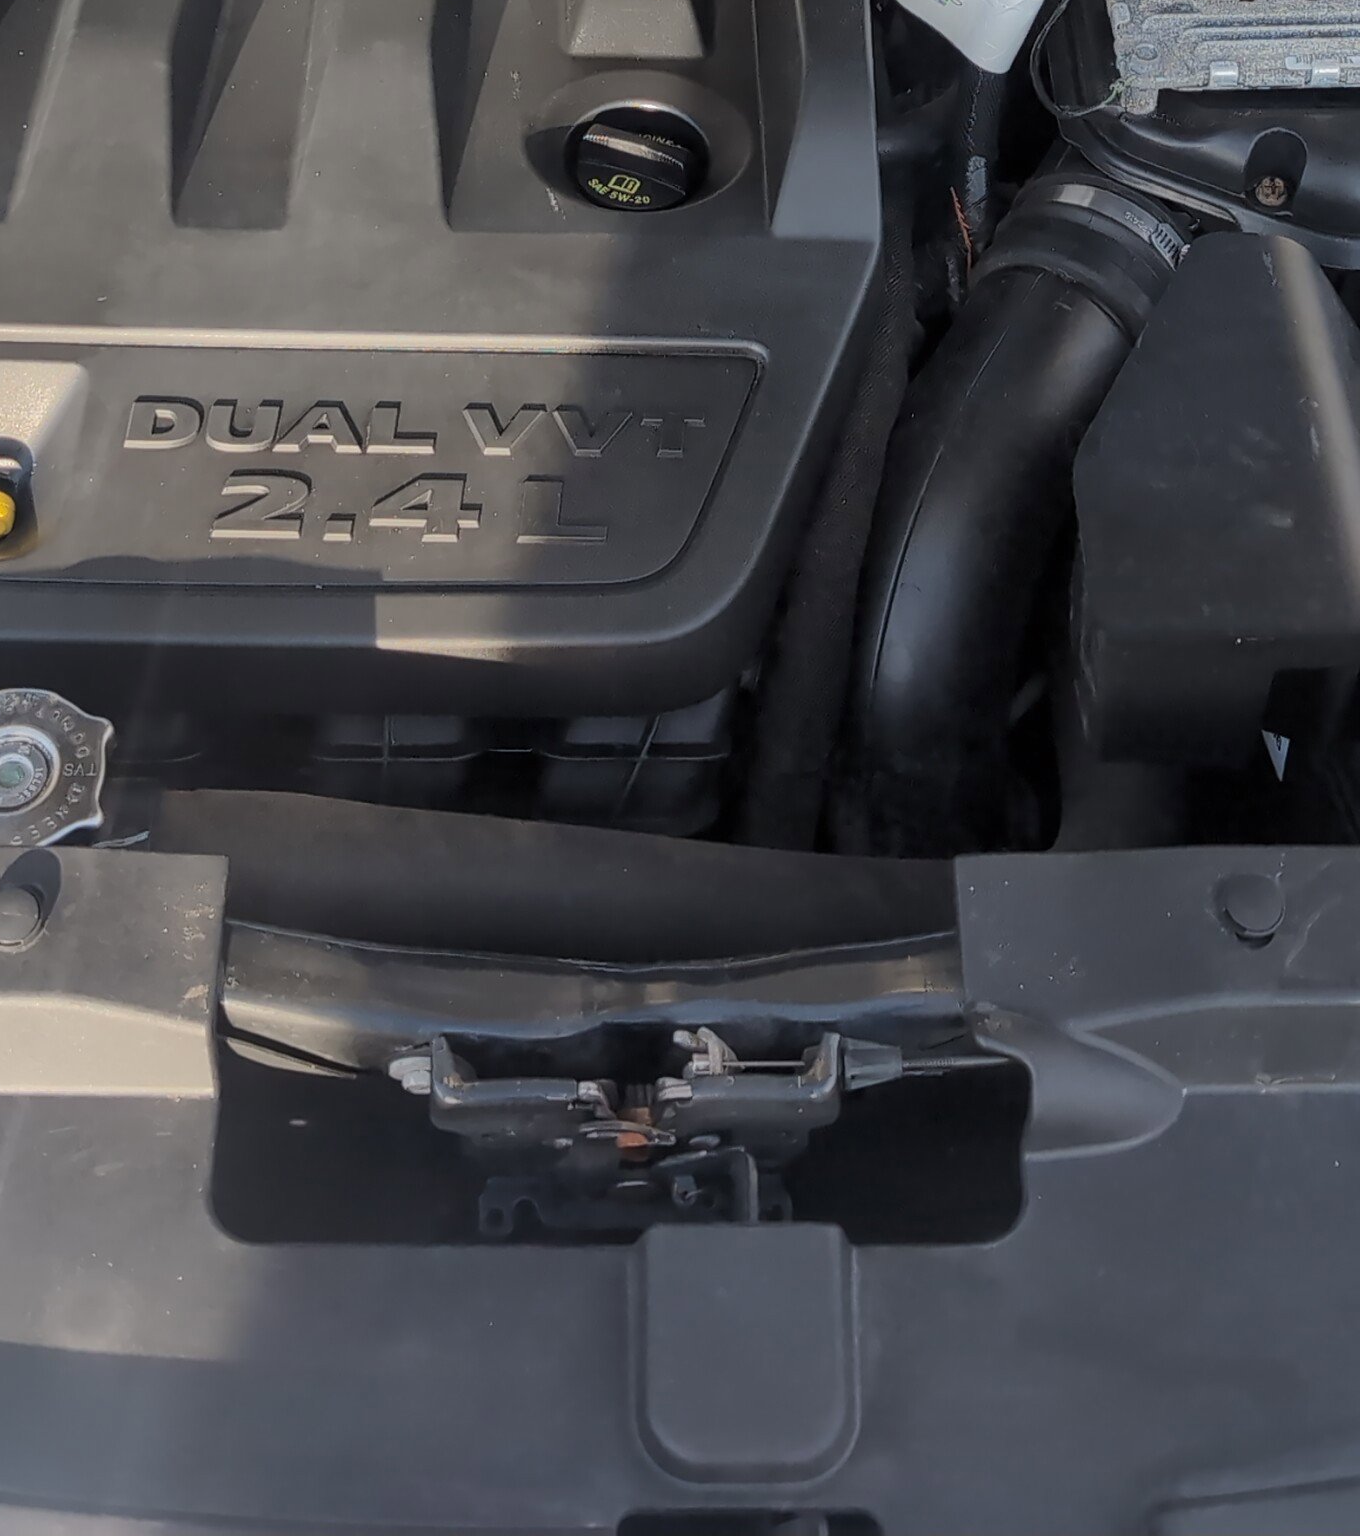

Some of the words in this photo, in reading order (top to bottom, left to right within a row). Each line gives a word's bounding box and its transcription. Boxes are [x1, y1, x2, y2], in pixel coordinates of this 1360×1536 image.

[588, 178, 610, 196] SAE
[609, 190, 651, 206] 5W-20
[123, 394, 438, 454] DUAL
[463, 402, 705, 459] VVT
[62, 762, 97, 777] TVS
